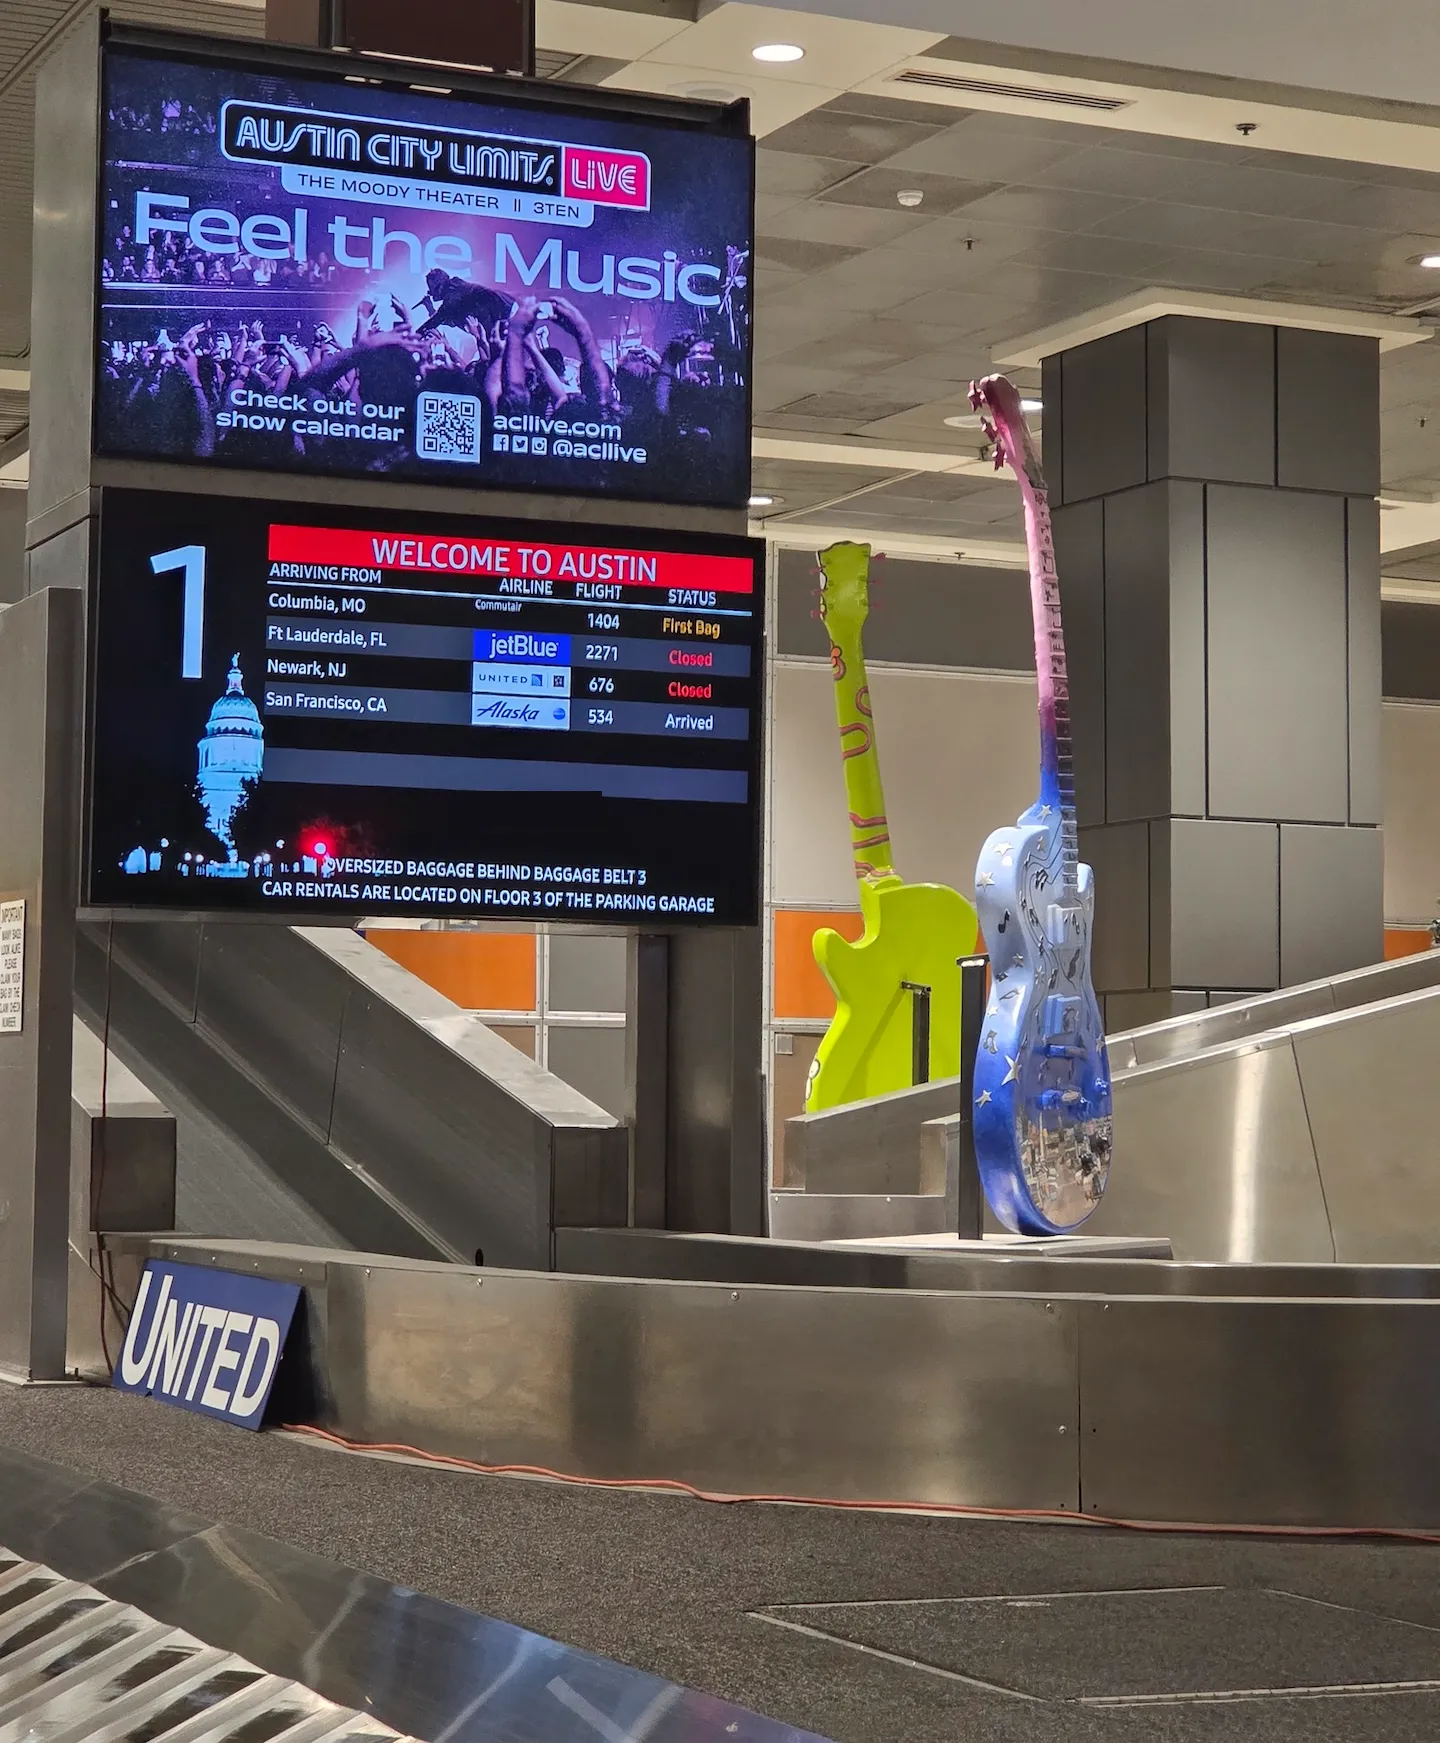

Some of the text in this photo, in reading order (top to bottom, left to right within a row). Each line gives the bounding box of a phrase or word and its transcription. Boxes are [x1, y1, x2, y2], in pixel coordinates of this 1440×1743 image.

[236, 116, 361, 162] AUSTIN
[367, 133, 443, 171] CITY
[298, 173, 335, 190] THE
[341, 179, 411, 199] MOODY
[415, 188, 499, 209] THEATER
[533, 201, 580, 219] 3TEN
[135, 190, 722, 307] Feel the Music
[230, 388, 406, 420] Check out our
[216, 410, 405, 442] show calendar
[493, 414, 622, 441] acllive.com
[552, 438, 648, 464] @acllive
[371, 537, 657, 583] WELCOME TO AUSTIN
[269, 562, 717, 607] ARRIVING FROM AIRLINE FLIGHT STATUS
[149, 544, 207, 680] 1
[268, 592, 339, 614] Columbia,
[341, 597, 366, 613] MO
[588, 612, 621, 630] 1404
[663, 617, 693, 635] First
[695, 619, 721, 640] Bag
[268, 625, 713, 667] Ft Lauderdale, FL jetBlue 2271 Closed
[267, 658, 712, 699] Newark, NJ UNITED 676 Closed
[265, 691, 714, 731] San Francisco, CA Alaska 534 Arrived
[327, 856, 648, 887] OVERSIZED BAGGAGE BEHIND BAGGAGE BELT 3
[262, 881, 715, 914] CAR RENTALS ARE LOCATED ON FLOOR 3 OF THE PARKING GARAGE
[122, 1270, 281, 1417] UNITED
